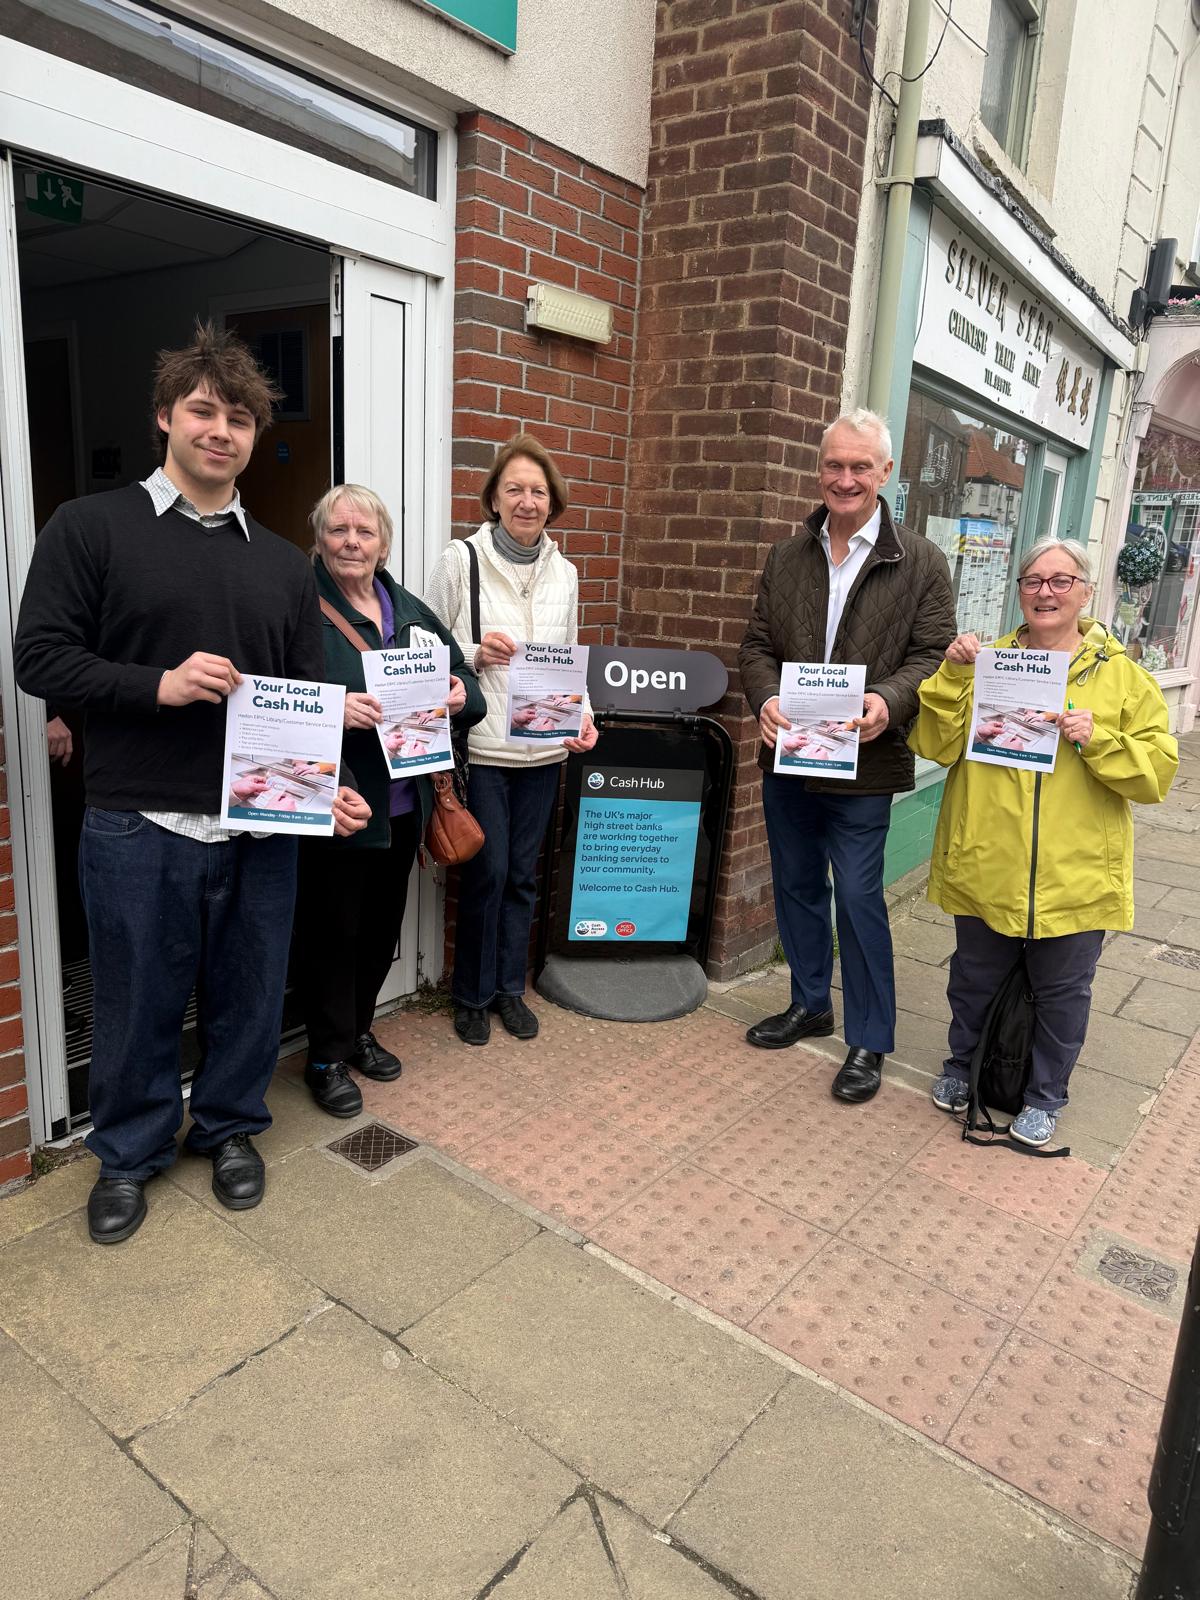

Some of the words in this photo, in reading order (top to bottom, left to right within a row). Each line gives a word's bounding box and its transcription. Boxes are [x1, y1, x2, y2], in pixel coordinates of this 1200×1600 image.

[945, 239, 1008, 333] SILVER
[1017, 300, 1053, 363] STAR
[949, 308, 988, 355] CHINESE
[994, 341, 1016, 373] TAKE
[526, 644, 546, 653] Your
[548, 645, 571, 655] Local
[381, 652, 404, 662] Your
[407, 650, 432, 660] Local
[525, 654, 550, 663] Cash
[552, 655, 574, 665] Hub
[995, 651, 1018, 660] Your
[1022, 652, 1049, 661] Local
[384, 664, 412, 676] Cash
[414, 663, 436, 673] Hub
[822, 667, 847, 675] Local
[994, 662, 1024, 672] Cash
[1027, 664, 1051, 674] Hub
[604, 661, 686, 693] Open
[253, 680, 283, 692] Your
[287, 683, 320, 697] Local
[798, 678, 823, 687] Cash
[827, 679, 849, 688] Hub
[252, 696, 288, 710] Cash
[293, 699, 323, 714] Hub
[610, 777, 638, 788] Cash
[640, 777, 664, 789] Hub
[585, 810, 602, 819] The
[604, 811, 624, 819] UK's
[627, 812, 652, 821] major
[584, 822, 604, 830] high
[600, 833, 636, 842] working
[639, 834, 678, 843] together
[594, 843, 618, 852] bring
[621, 844, 661, 854] everyday
[581, 854, 618, 863] banking
[602, 866, 655, 875] community.
[579, 883, 621, 892] Welcome
